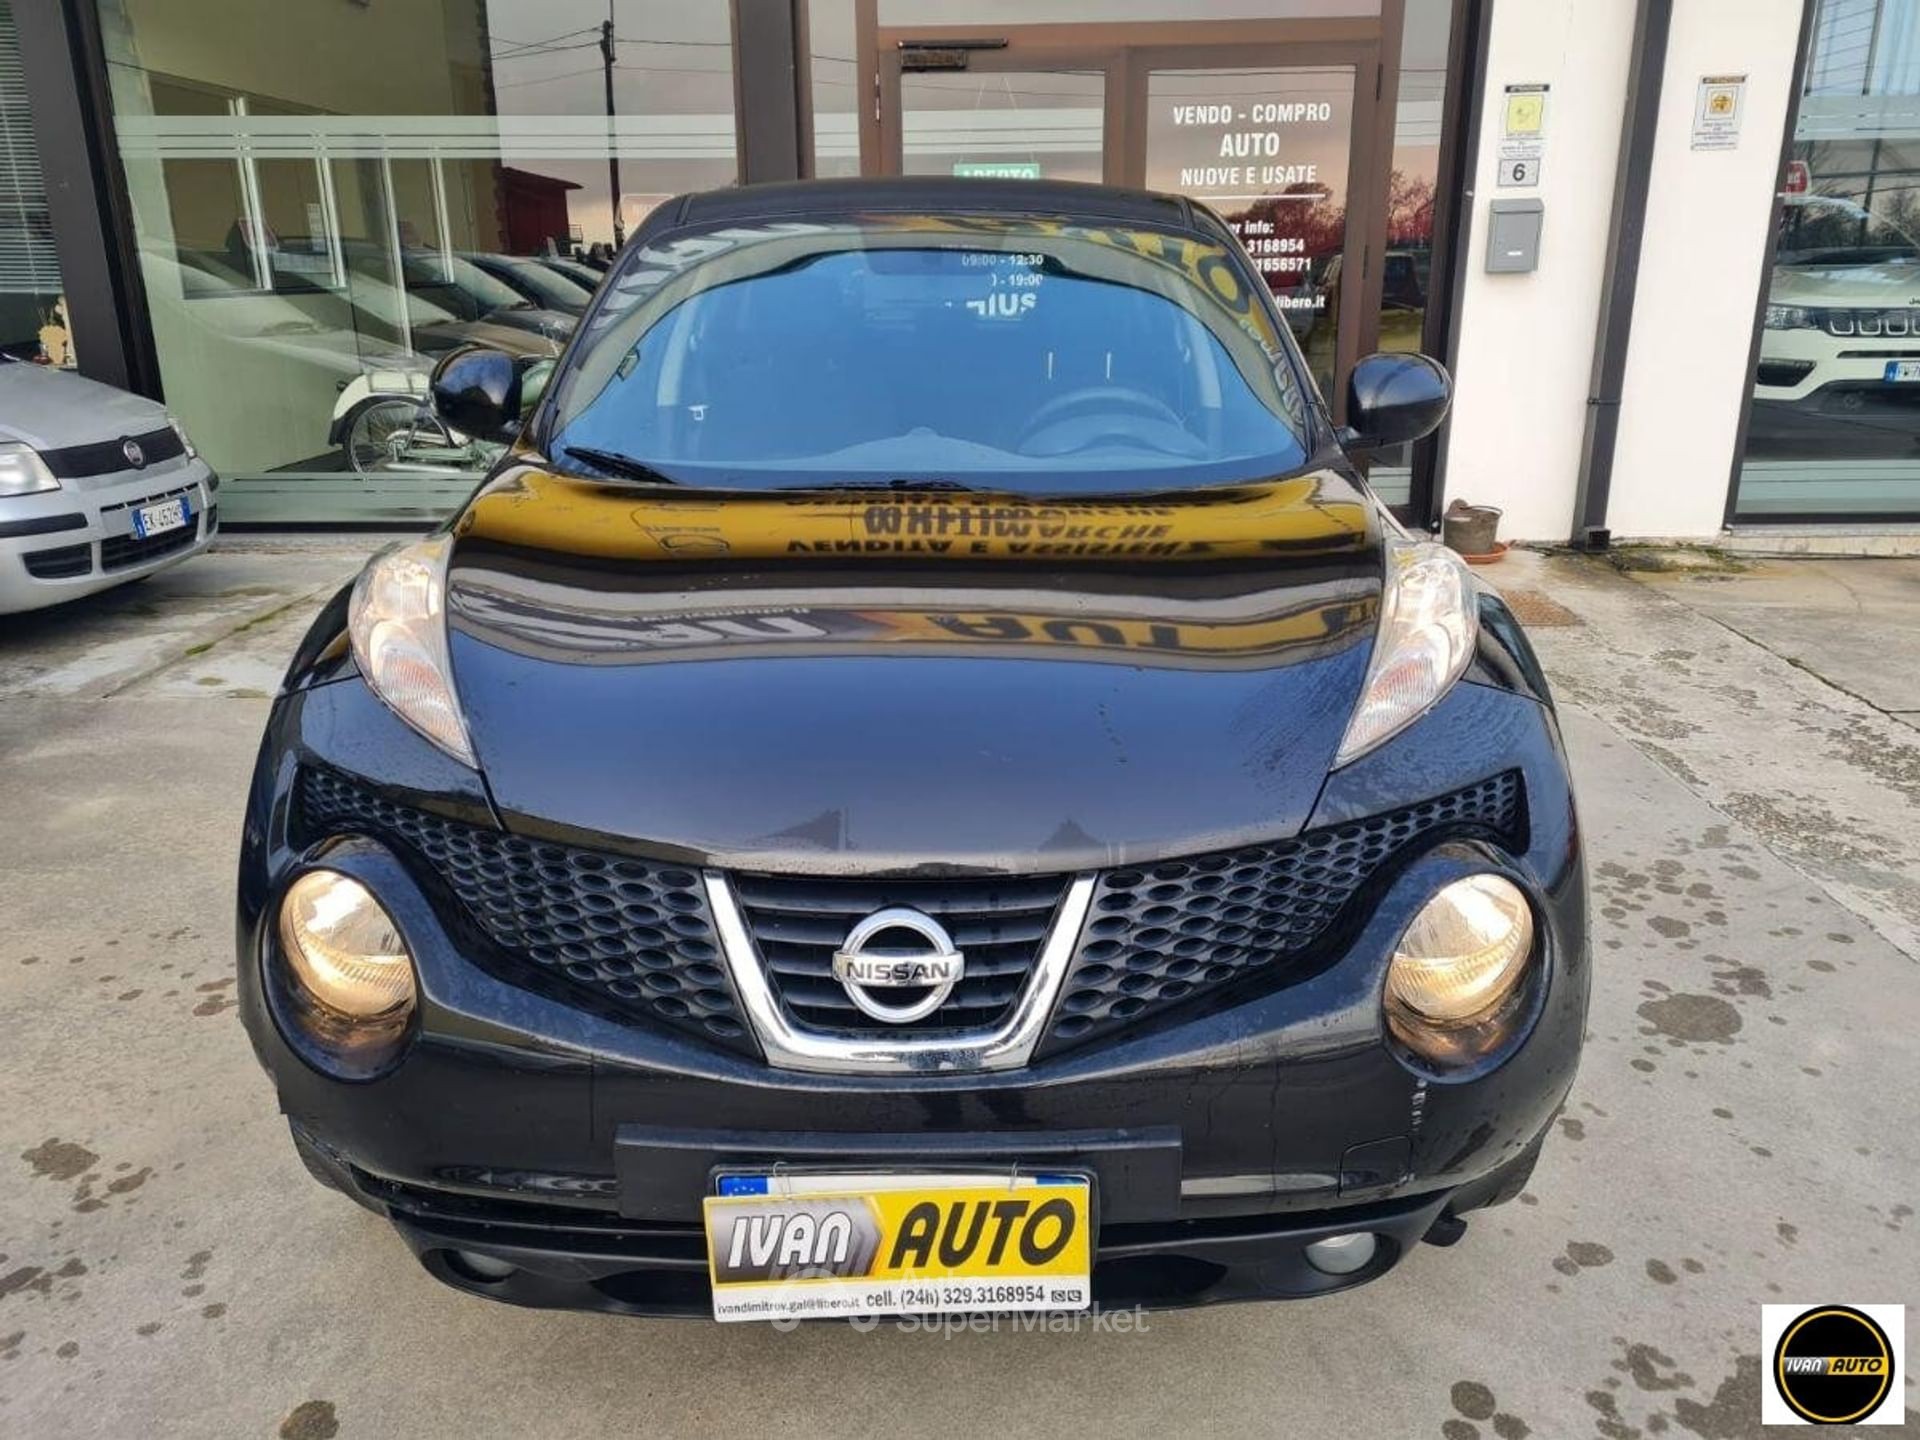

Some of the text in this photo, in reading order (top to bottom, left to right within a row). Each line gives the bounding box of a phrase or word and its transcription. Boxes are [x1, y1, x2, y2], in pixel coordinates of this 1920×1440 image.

[1173, 105, 1232, 124] VENDO
[1252, 102, 1331, 123] COMPRO
[1219, 132, 1280, 157] AUTO
[1181, 164, 1318, 186] NUOVE E USATE
[1512, 162, 1526, 182] 6
[1244, 220, 1275, 234] info:
[1009, 253, 1044, 266] 12:30
[846, 961, 950, 980] NISSAN
[727, 1198, 1076, 1269] IVAN AUTO
[866, 1289, 897, 1308] cell.
[901, 1288, 939, 1309] (24h)
[943, 1285, 1045, 1306] 329.3168954
